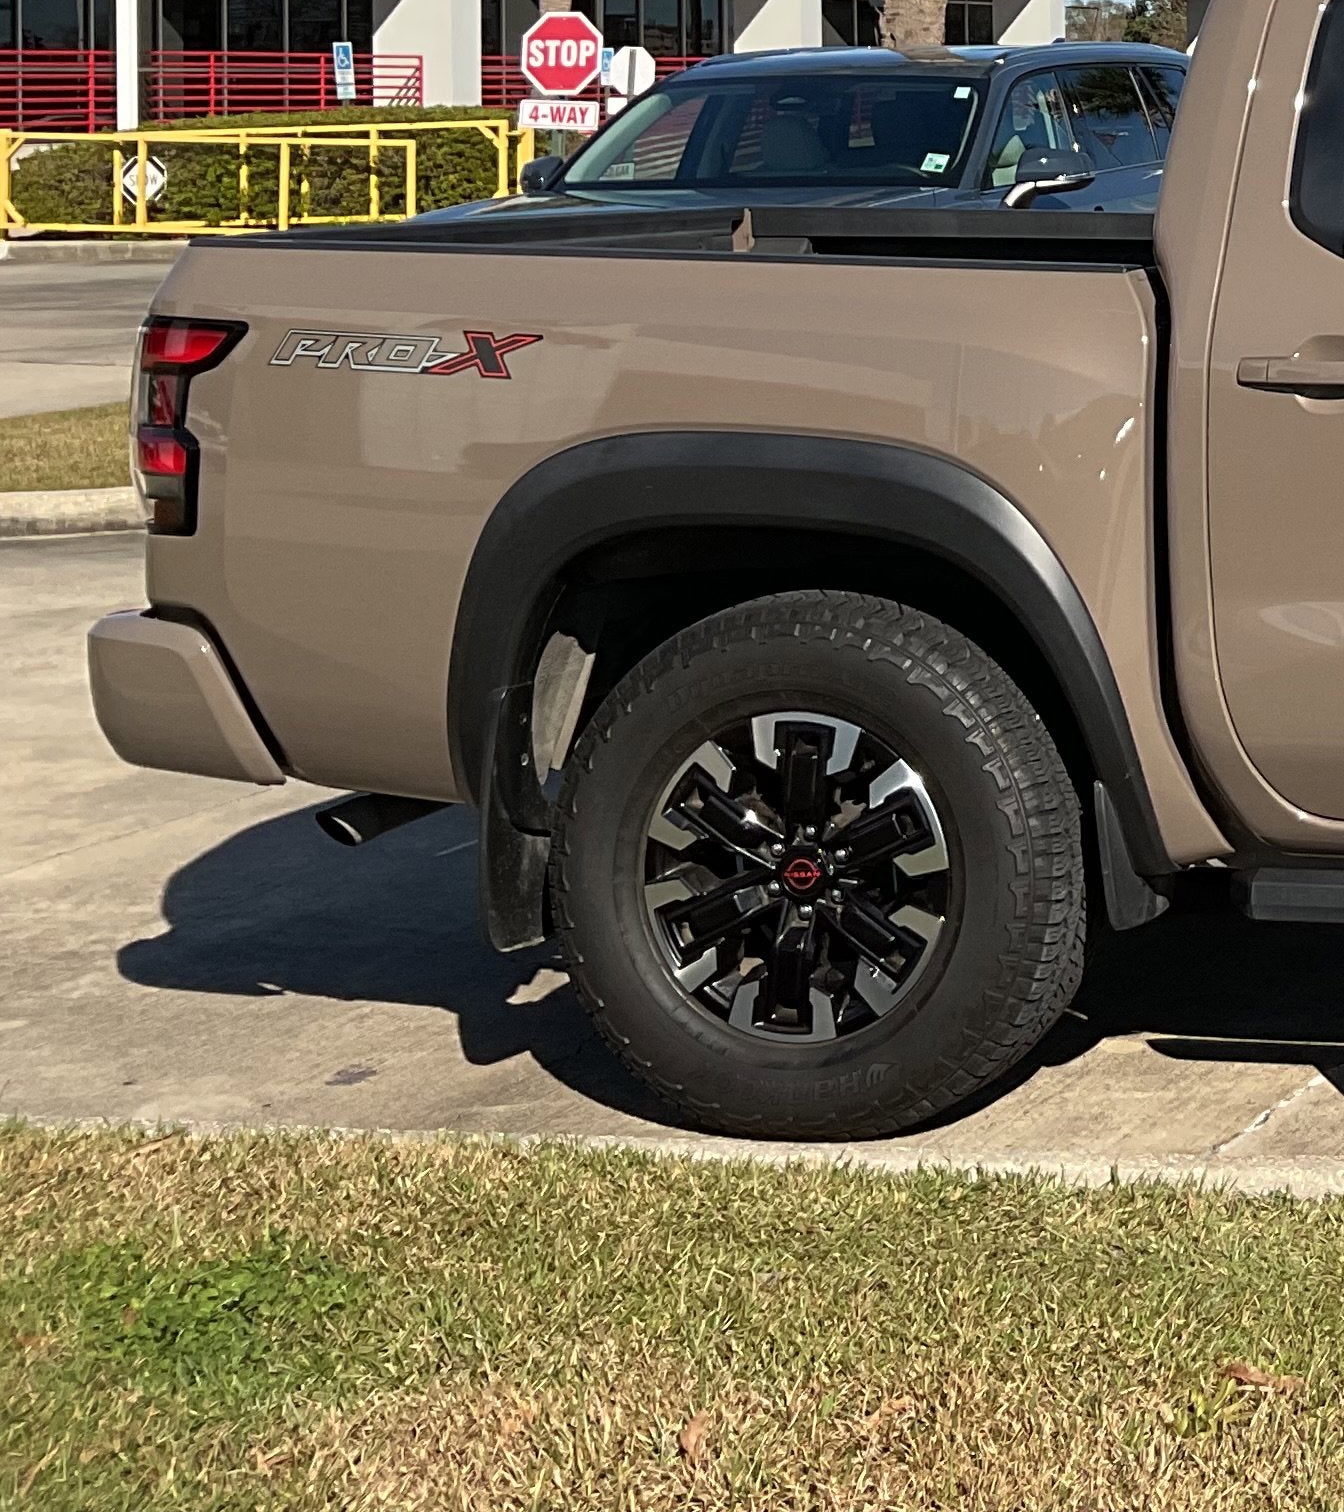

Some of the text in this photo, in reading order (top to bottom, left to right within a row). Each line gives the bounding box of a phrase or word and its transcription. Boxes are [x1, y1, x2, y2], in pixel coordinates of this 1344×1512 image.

[529, 39, 596, 68] STOP
[529, 105, 589, 124] 4-WAY
[128, 174, 158, 187] SW
